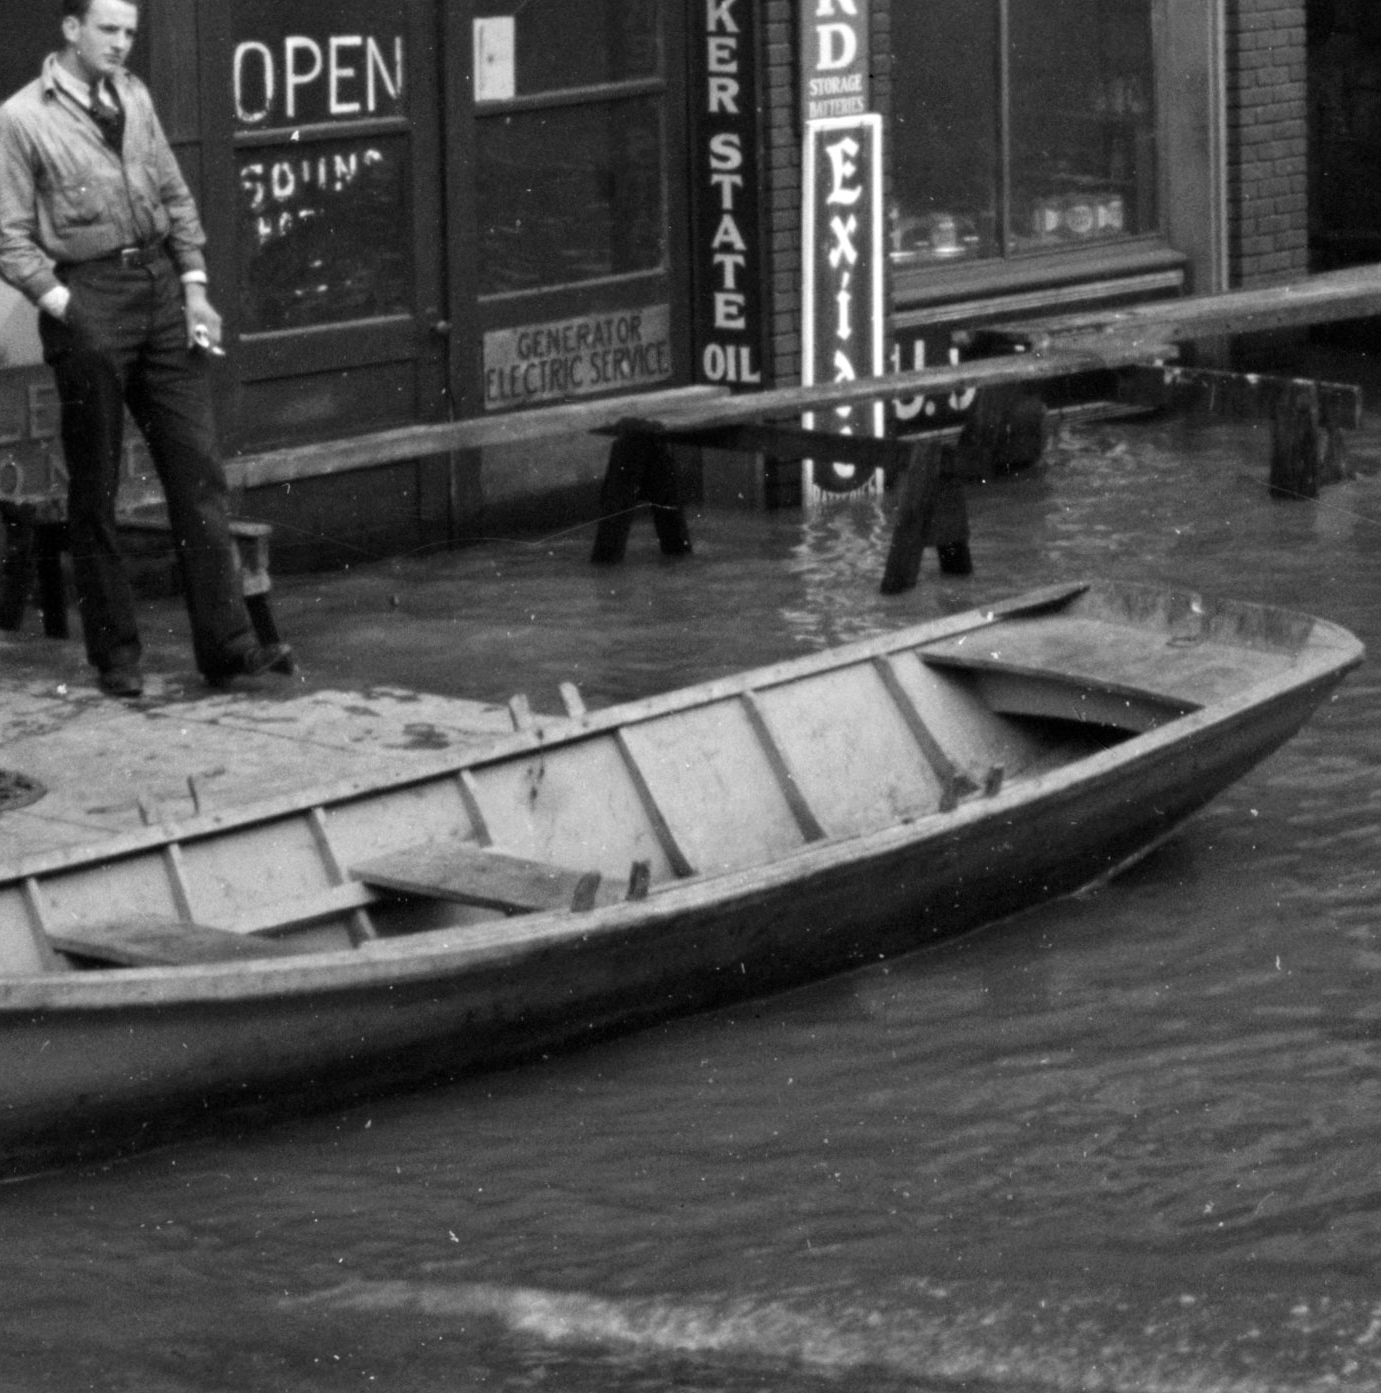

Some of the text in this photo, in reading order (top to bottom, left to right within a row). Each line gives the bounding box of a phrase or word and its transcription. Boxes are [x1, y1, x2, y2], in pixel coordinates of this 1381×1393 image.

[232, 36, 404, 121] OPEN
[809, 74, 862, 97] STORAGE
[709, 134, 748, 330] STATE
[516, 314, 643, 361] GENERATOR
[703, 343, 761, 384] OIL
[485, 341, 669, 401] ELECTRIC SERVICE
